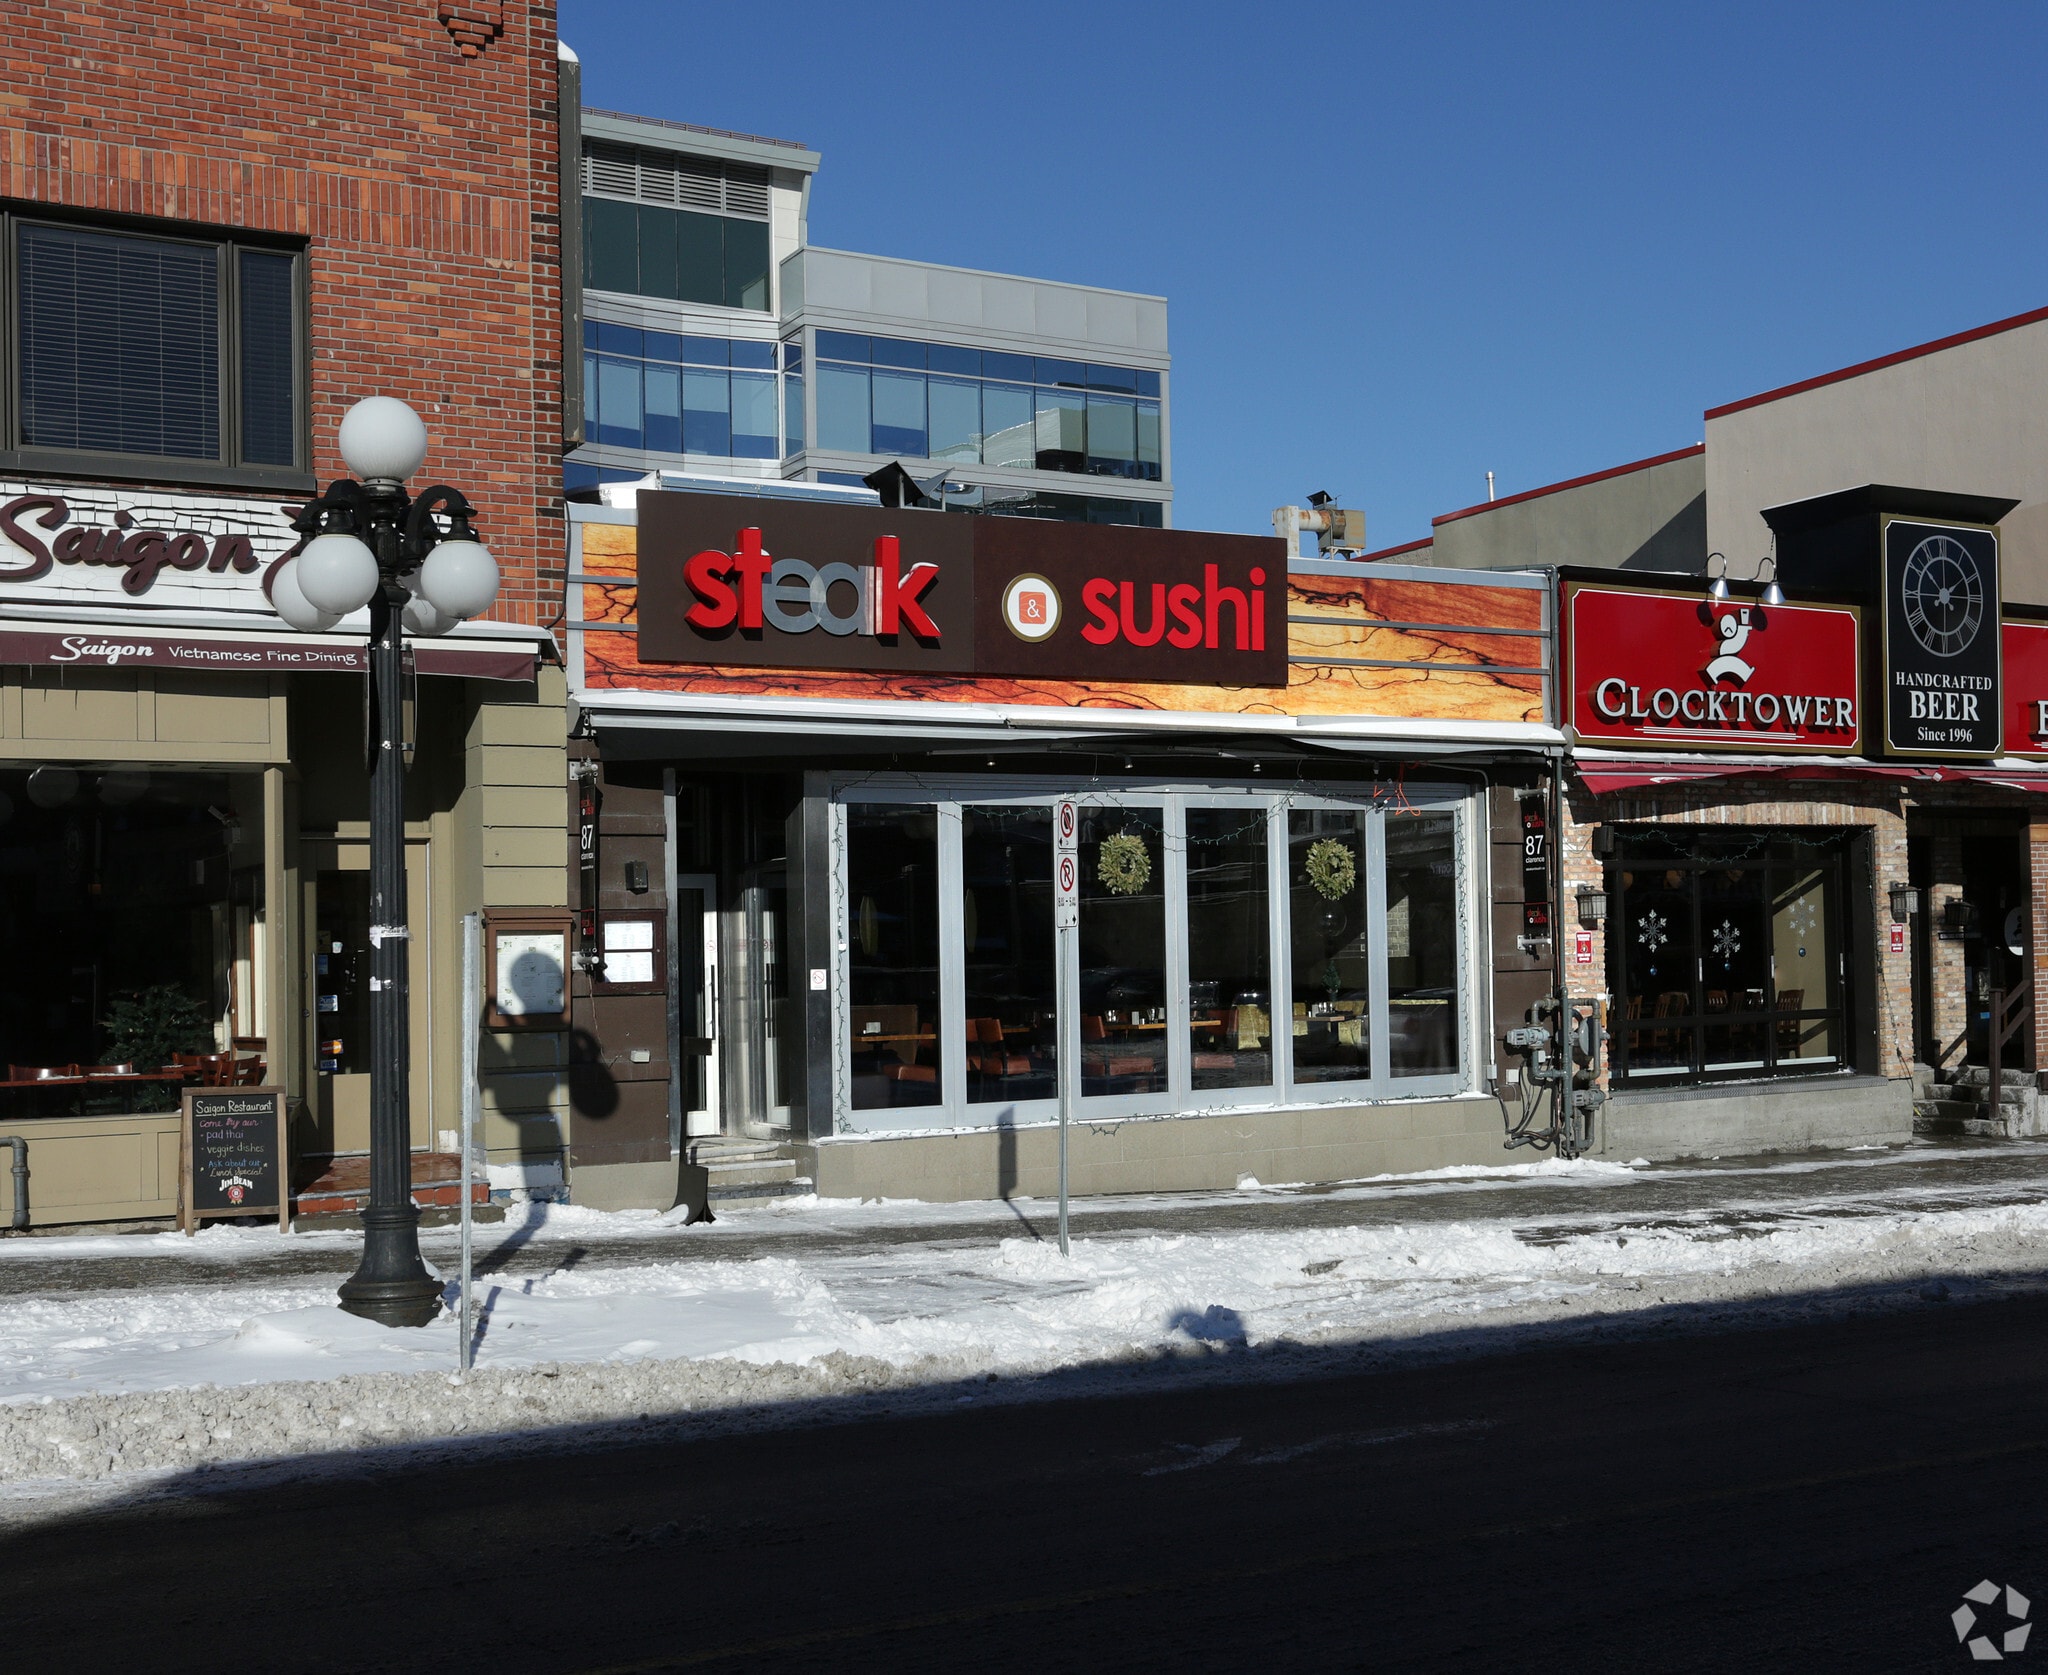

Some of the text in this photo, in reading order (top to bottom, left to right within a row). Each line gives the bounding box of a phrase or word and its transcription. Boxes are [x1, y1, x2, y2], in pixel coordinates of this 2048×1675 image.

[0, 494, 260, 594] Saigon
[684, 526, 1267, 651] steak & sushi
[50, 636, 357, 666] Saigon Vietnamese Fine Dining
[1895, 671, 1993, 691] HANDCRAFTED
[1596, 677, 1856, 728] CLOCKTOWER
[1908, 690, 1981, 722] BEER
[1917, 726, 1973, 743] Since 1996
[581, 824, 594, 850] 87
[1525, 834, 1544, 856] 87
[195, 1100, 273, 1117] Saigon Restaurant
[206, 1129, 244, 1144] pad thai
[206, 1141, 265, 1159] veggie dishes
[224, 1158, 247, 1167] about
[232, 1175, 253, 1190] BEAM
